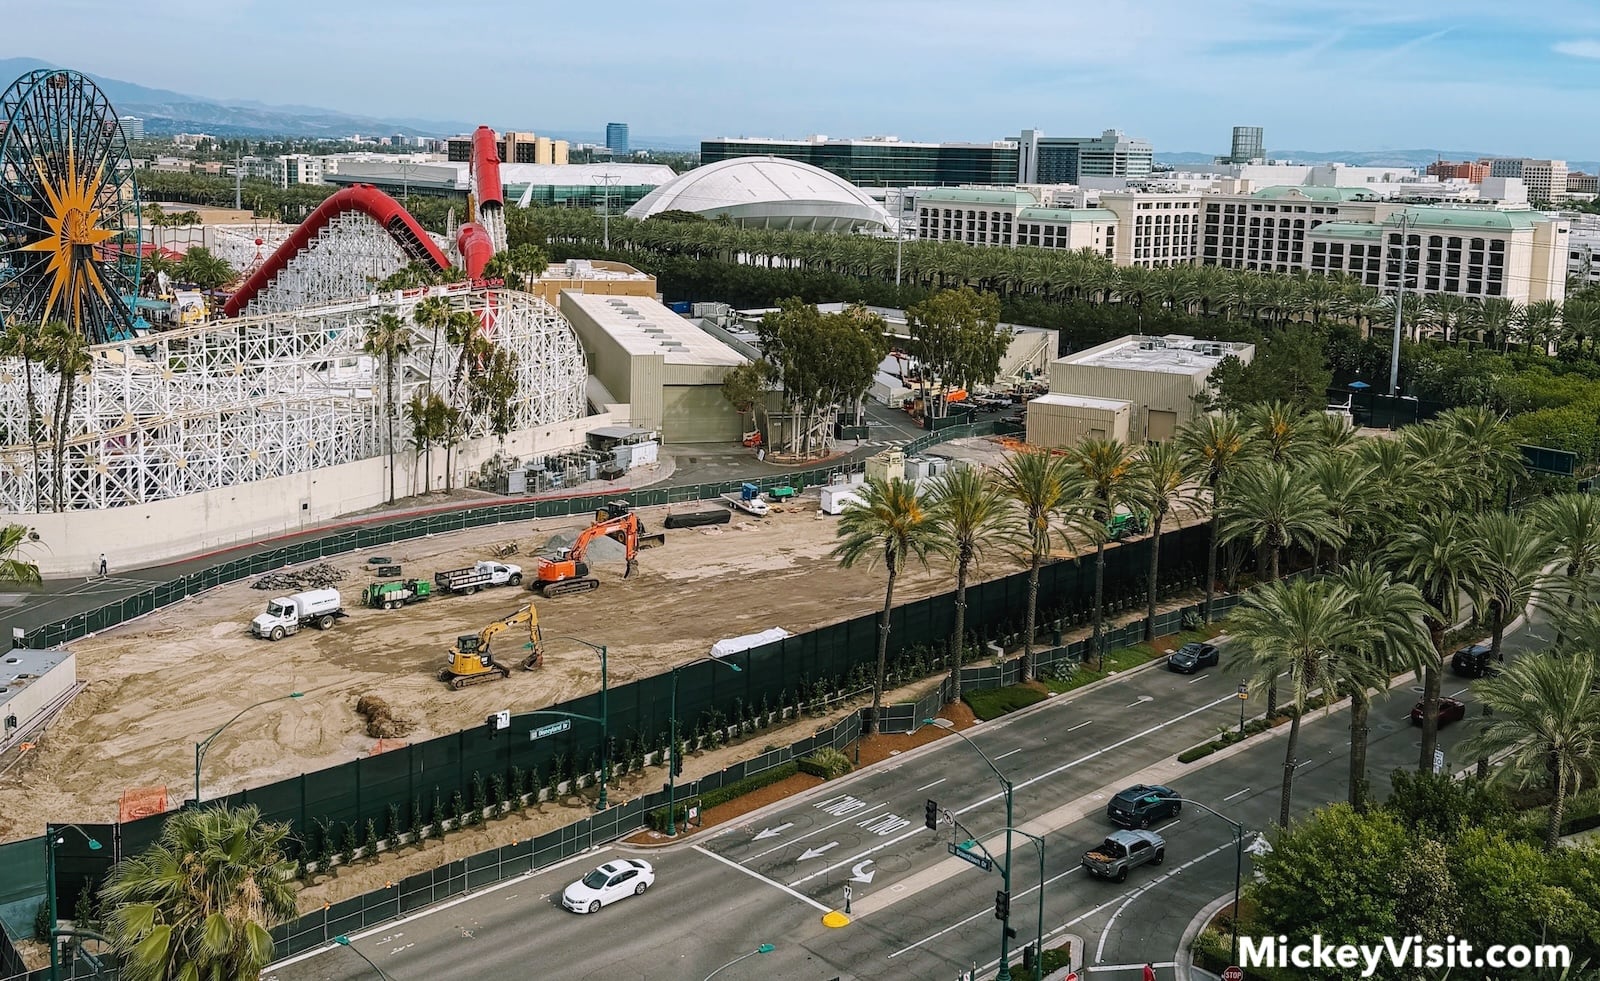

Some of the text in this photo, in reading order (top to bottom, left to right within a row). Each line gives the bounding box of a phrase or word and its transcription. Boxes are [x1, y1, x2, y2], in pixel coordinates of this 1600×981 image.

[812, 794, 867, 817] ONLY
[856, 812, 911, 836] ONLY
[956, 848, 981, 866] Downtown
[1225, 971, 1242, 979] STOP
